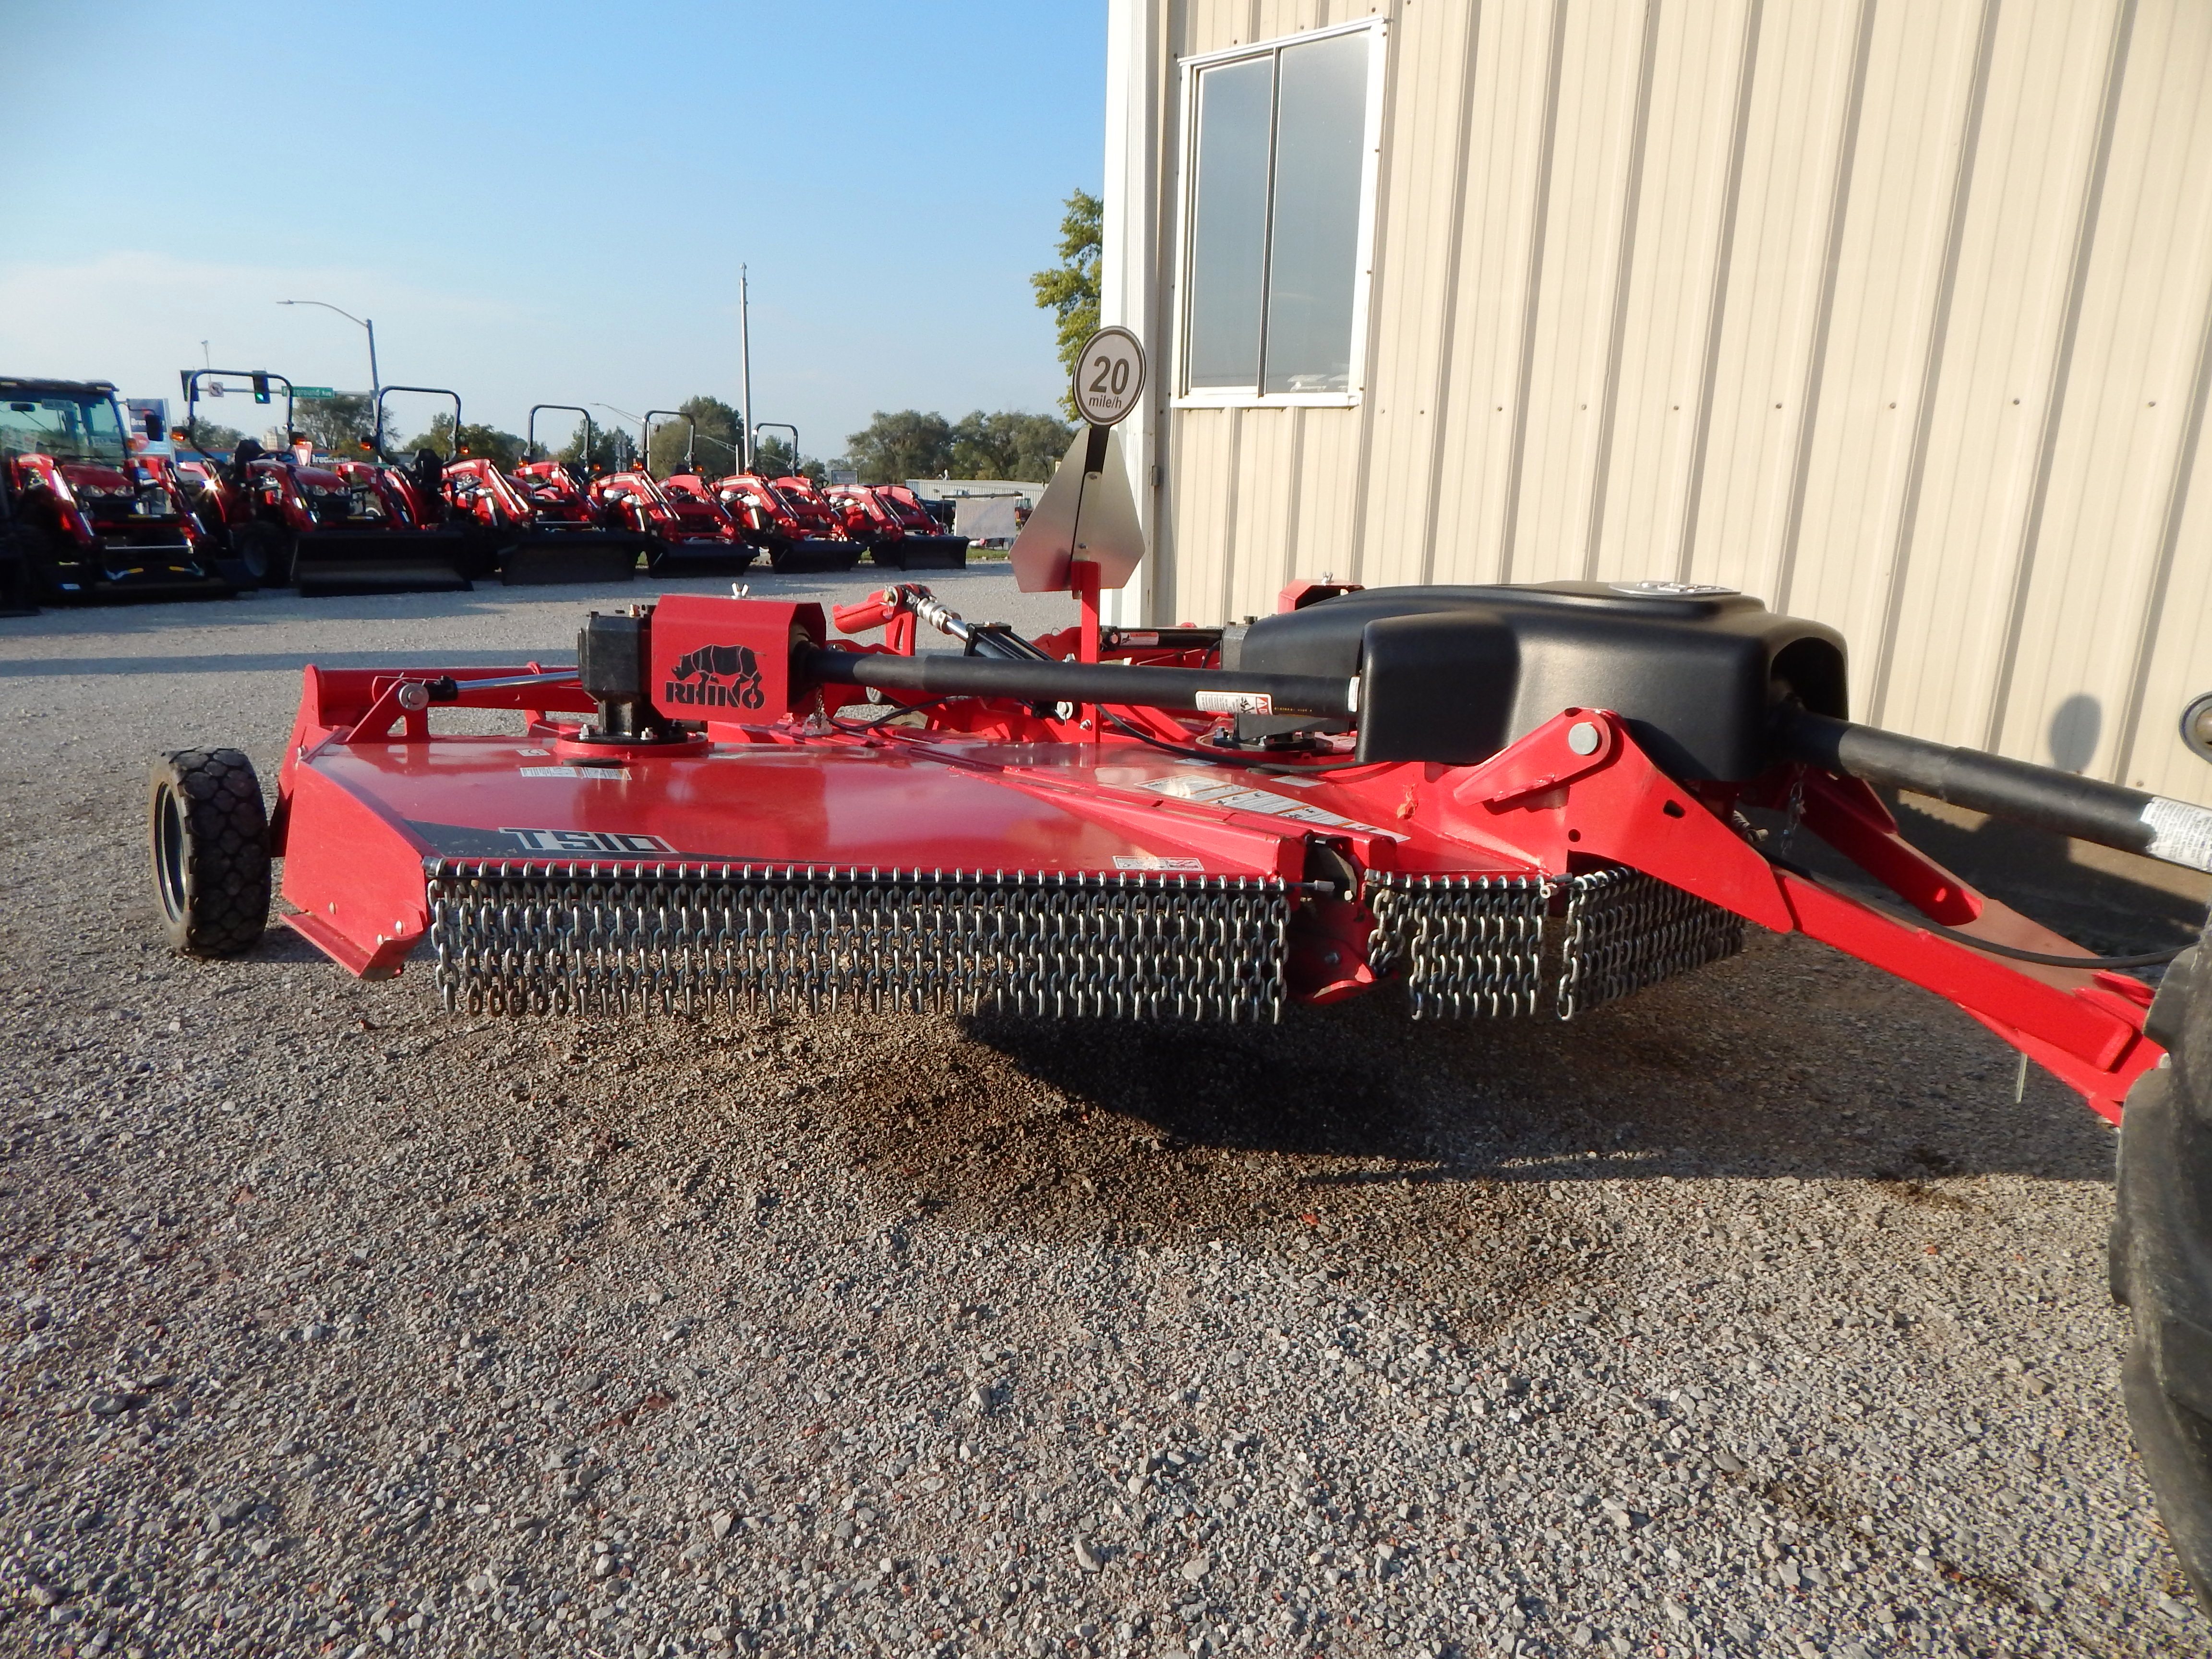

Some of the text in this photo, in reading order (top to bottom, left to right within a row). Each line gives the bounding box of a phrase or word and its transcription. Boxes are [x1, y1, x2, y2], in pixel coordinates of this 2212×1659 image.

[1089, 356, 1129, 395] 20
[1089, 395, 1122, 409] mile/h
[666, 681, 765, 709] RHINO
